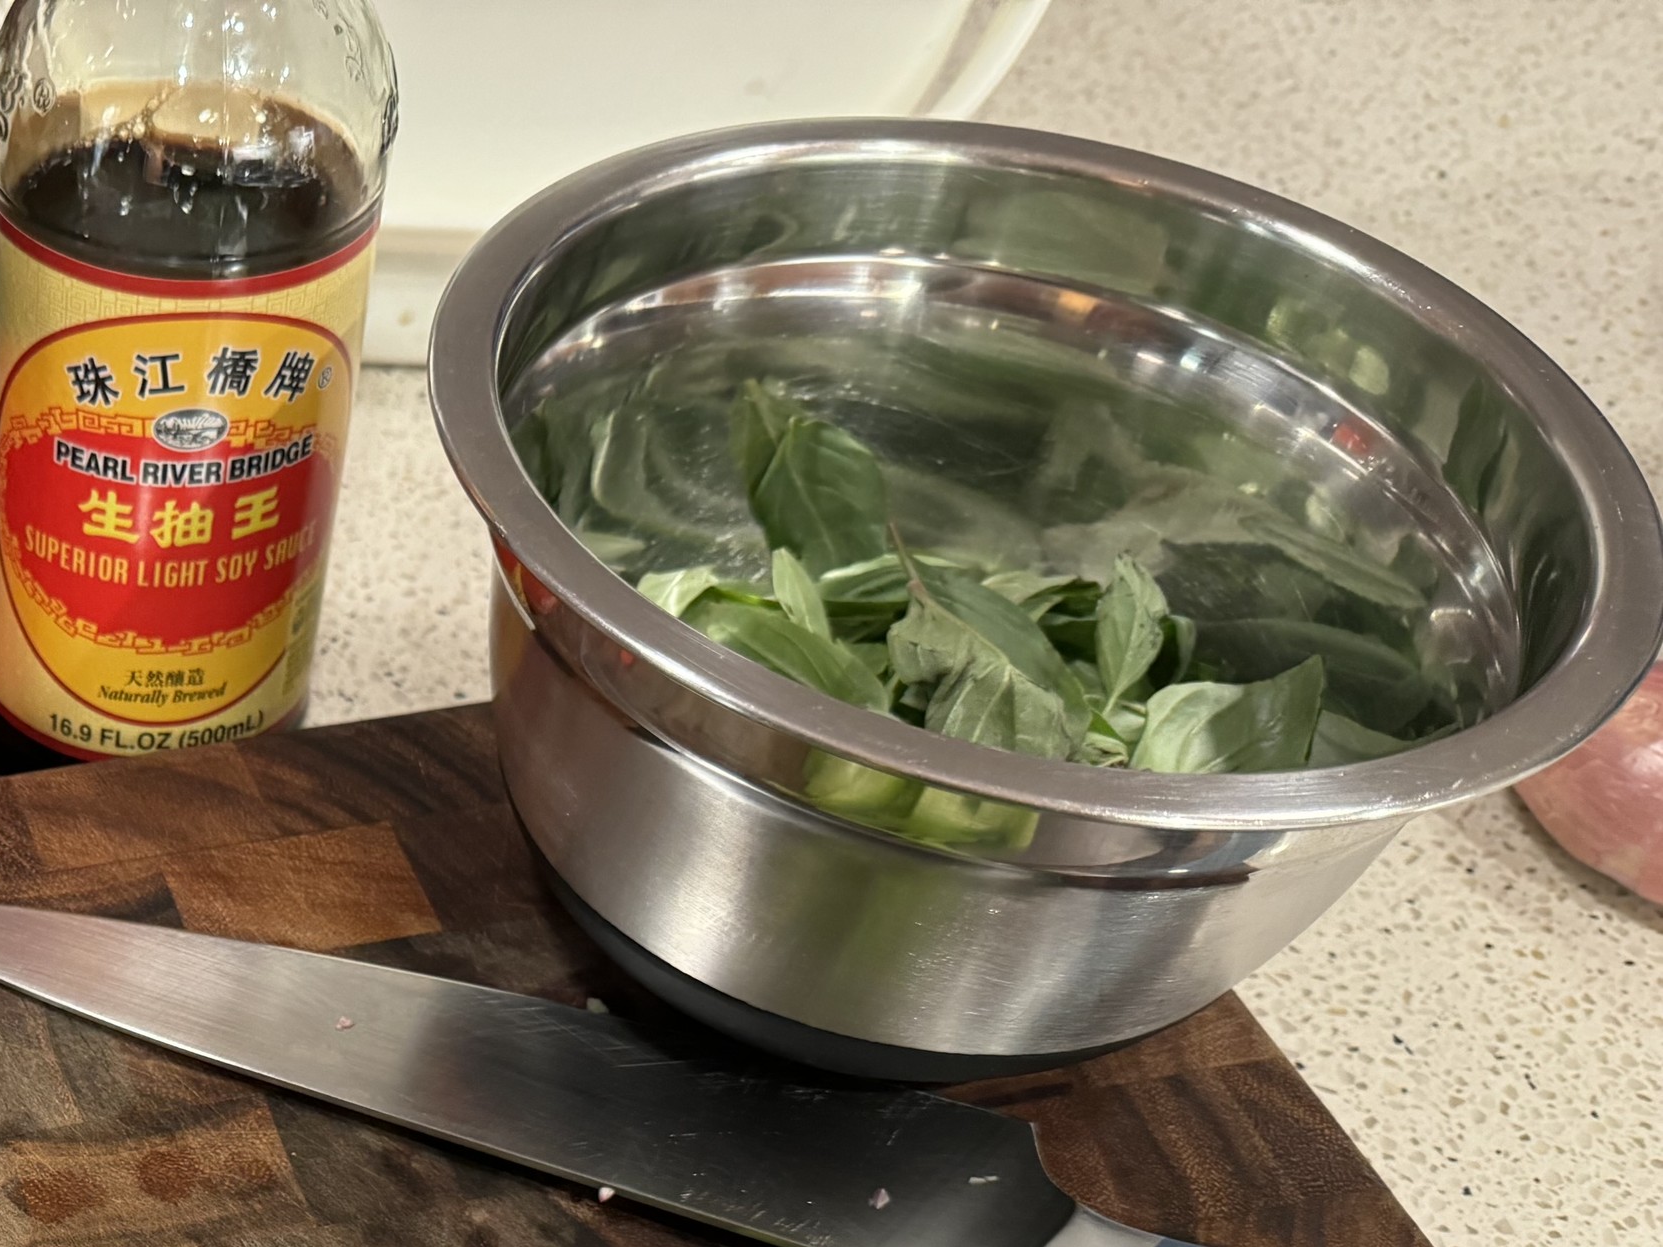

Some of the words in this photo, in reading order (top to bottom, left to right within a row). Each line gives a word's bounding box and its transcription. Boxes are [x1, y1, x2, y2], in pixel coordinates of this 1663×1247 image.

[66, 346, 316, 407] 珠江橋牌
[54, 438, 136, 484] PEARL
[141, 460, 223, 487] RIVER
[227, 432, 315, 481] BRIDGE
[78, 485, 280, 549] 生抽王
[24, 525, 129, 586] SUPERIOR
[138, 559, 209, 588] LIGHT
[216, 549, 259, 583] SOY
[263, 518, 318, 571] SAUCE
[97, 684, 170, 708] Naturally
[172, 681, 228, 703] Brewed
[49, 713, 92, 742] 16.9
[99, 728, 172, 750] FL.OZ
[178, 710, 264, 750] (500mL)
